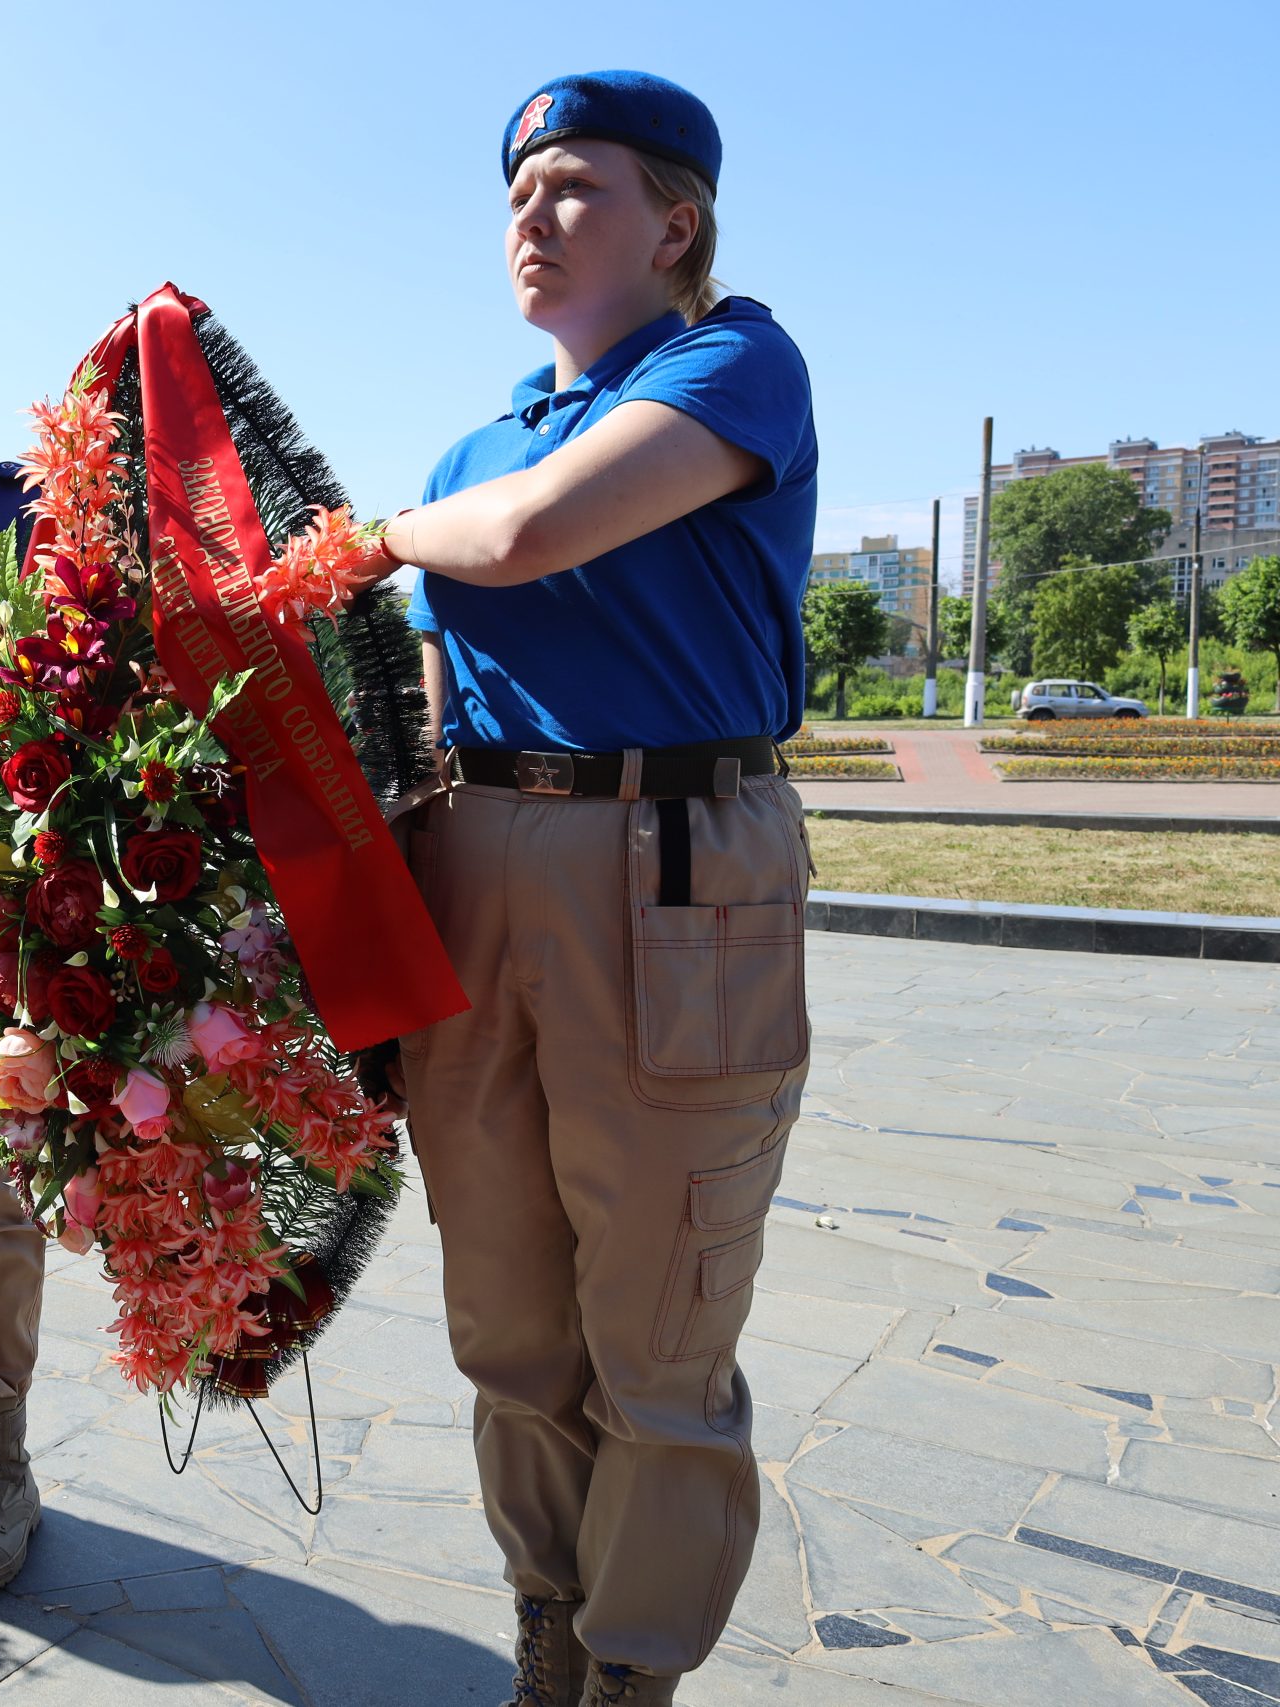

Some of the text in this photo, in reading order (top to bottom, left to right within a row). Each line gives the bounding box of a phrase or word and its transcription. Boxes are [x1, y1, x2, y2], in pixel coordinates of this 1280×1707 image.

[151, 536, 287, 782] САНКТ-ПЕТБУРГА
[178, 457, 375, 852] ЗАКОНОДАТЕЛЬНОГО СОБРАНИЯ
